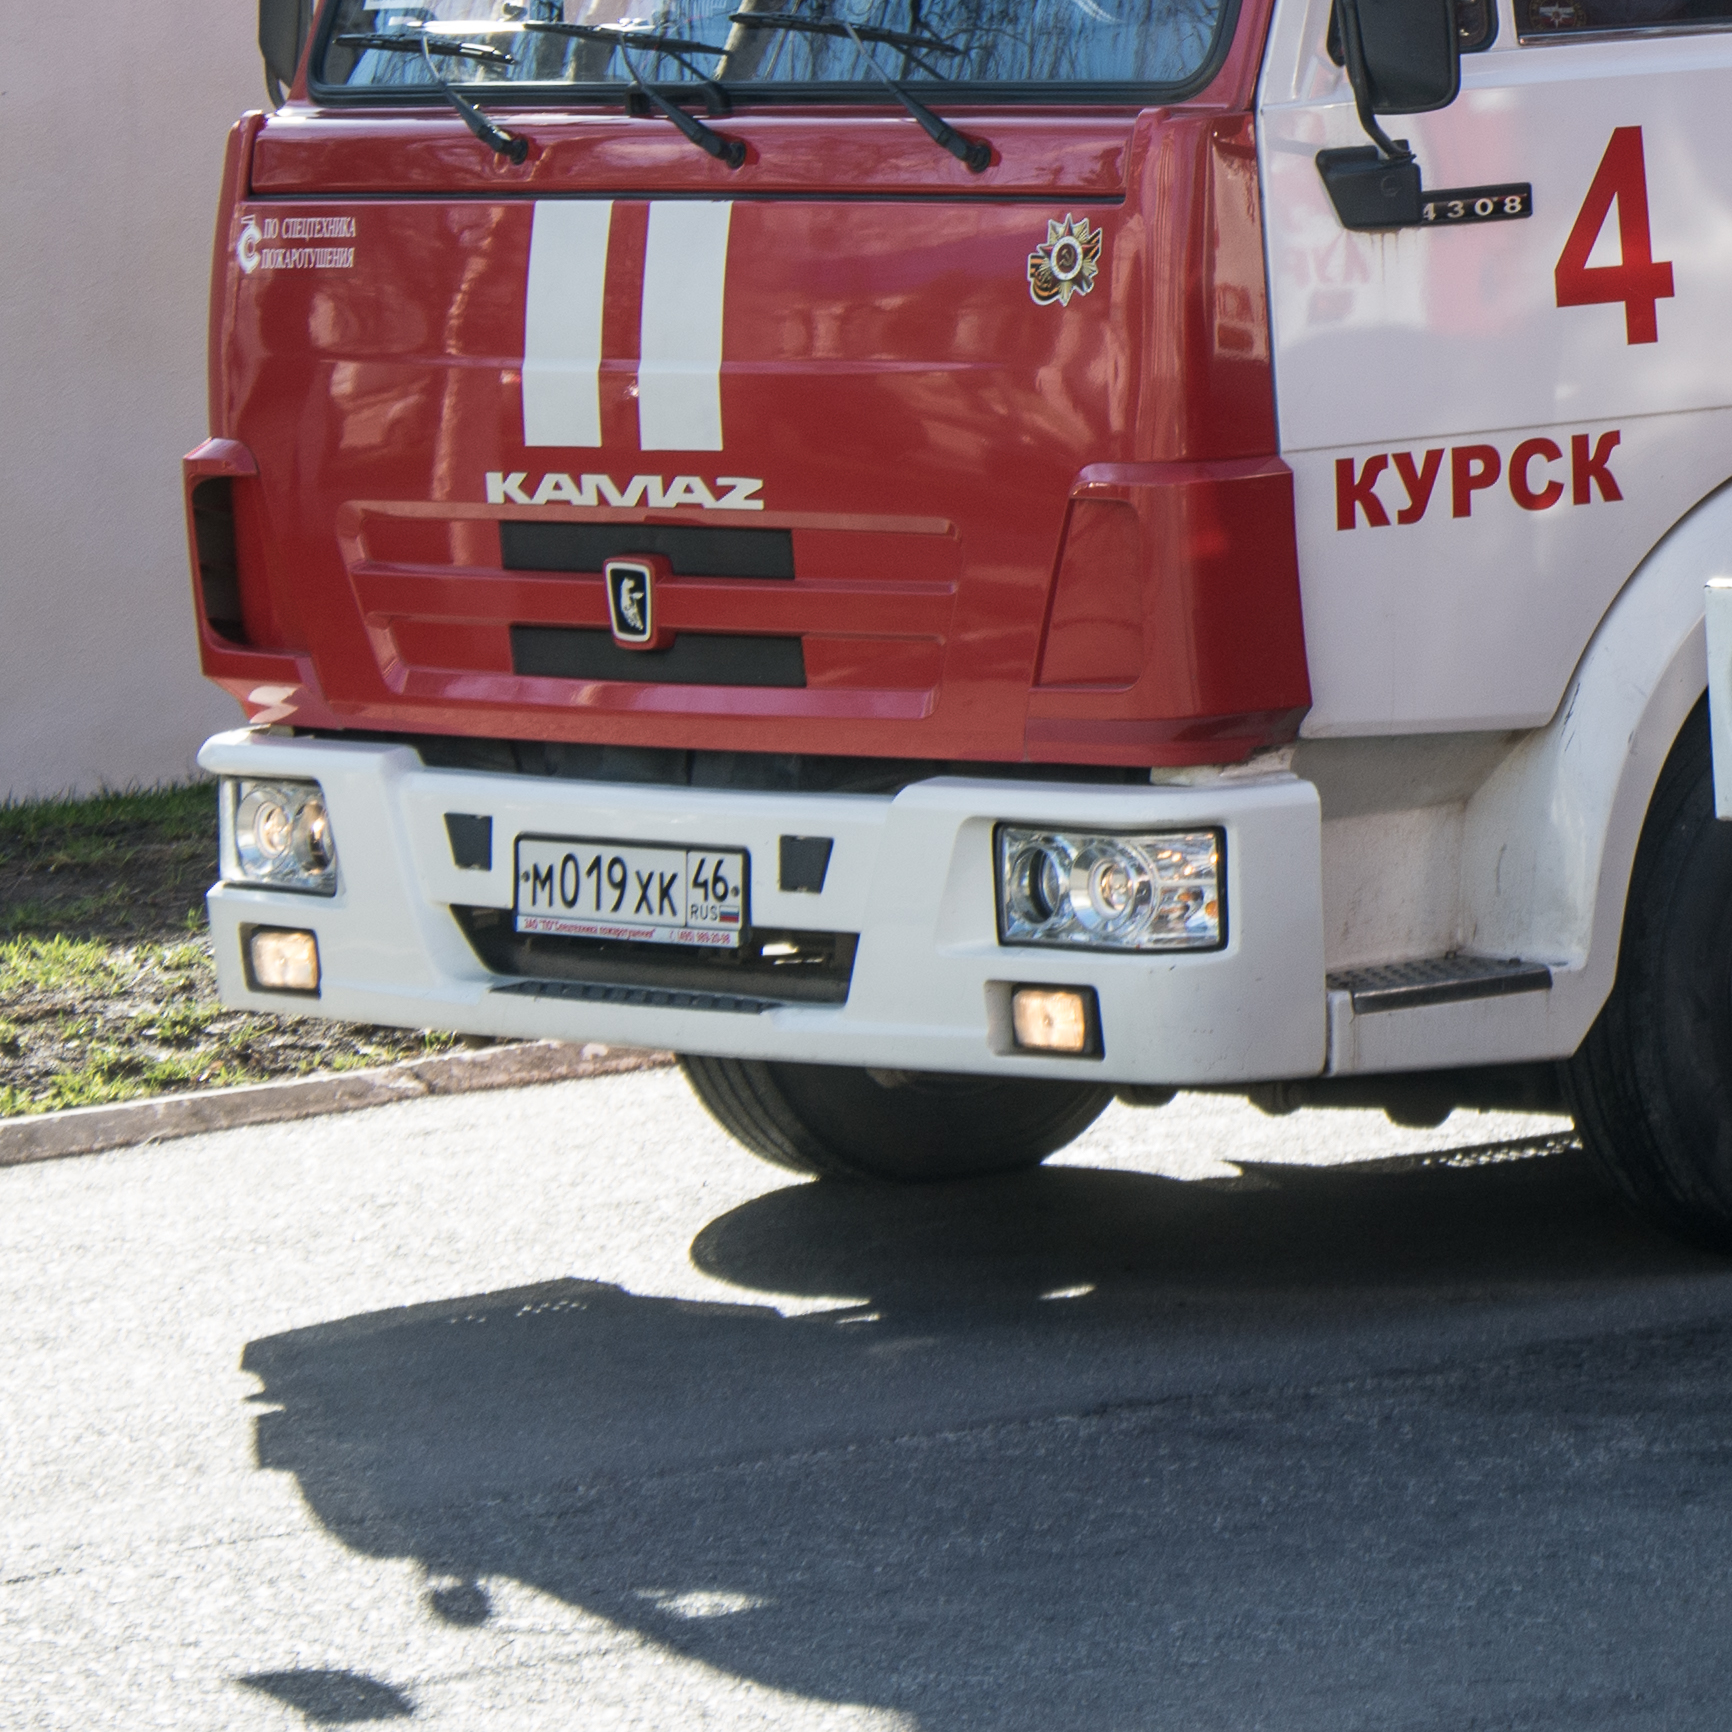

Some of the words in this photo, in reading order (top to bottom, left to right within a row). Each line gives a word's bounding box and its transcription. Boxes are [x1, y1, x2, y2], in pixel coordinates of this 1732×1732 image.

[1423, 195, 1522, 221] 4308
[263, 217, 279, 239] ПО
[281, 217, 356, 242] СПЕЦТЕХНИКА
[1554, 125, 1675, 345] 4
[261, 247, 355, 269] ПОЖАРОТУШЕНИЯ
[485, 471, 764, 510] KAMAZ
[1335, 429, 1624, 531] КУРСК
[692, 857, 729, 902] 46
[690, 904, 718, 921] RUS
